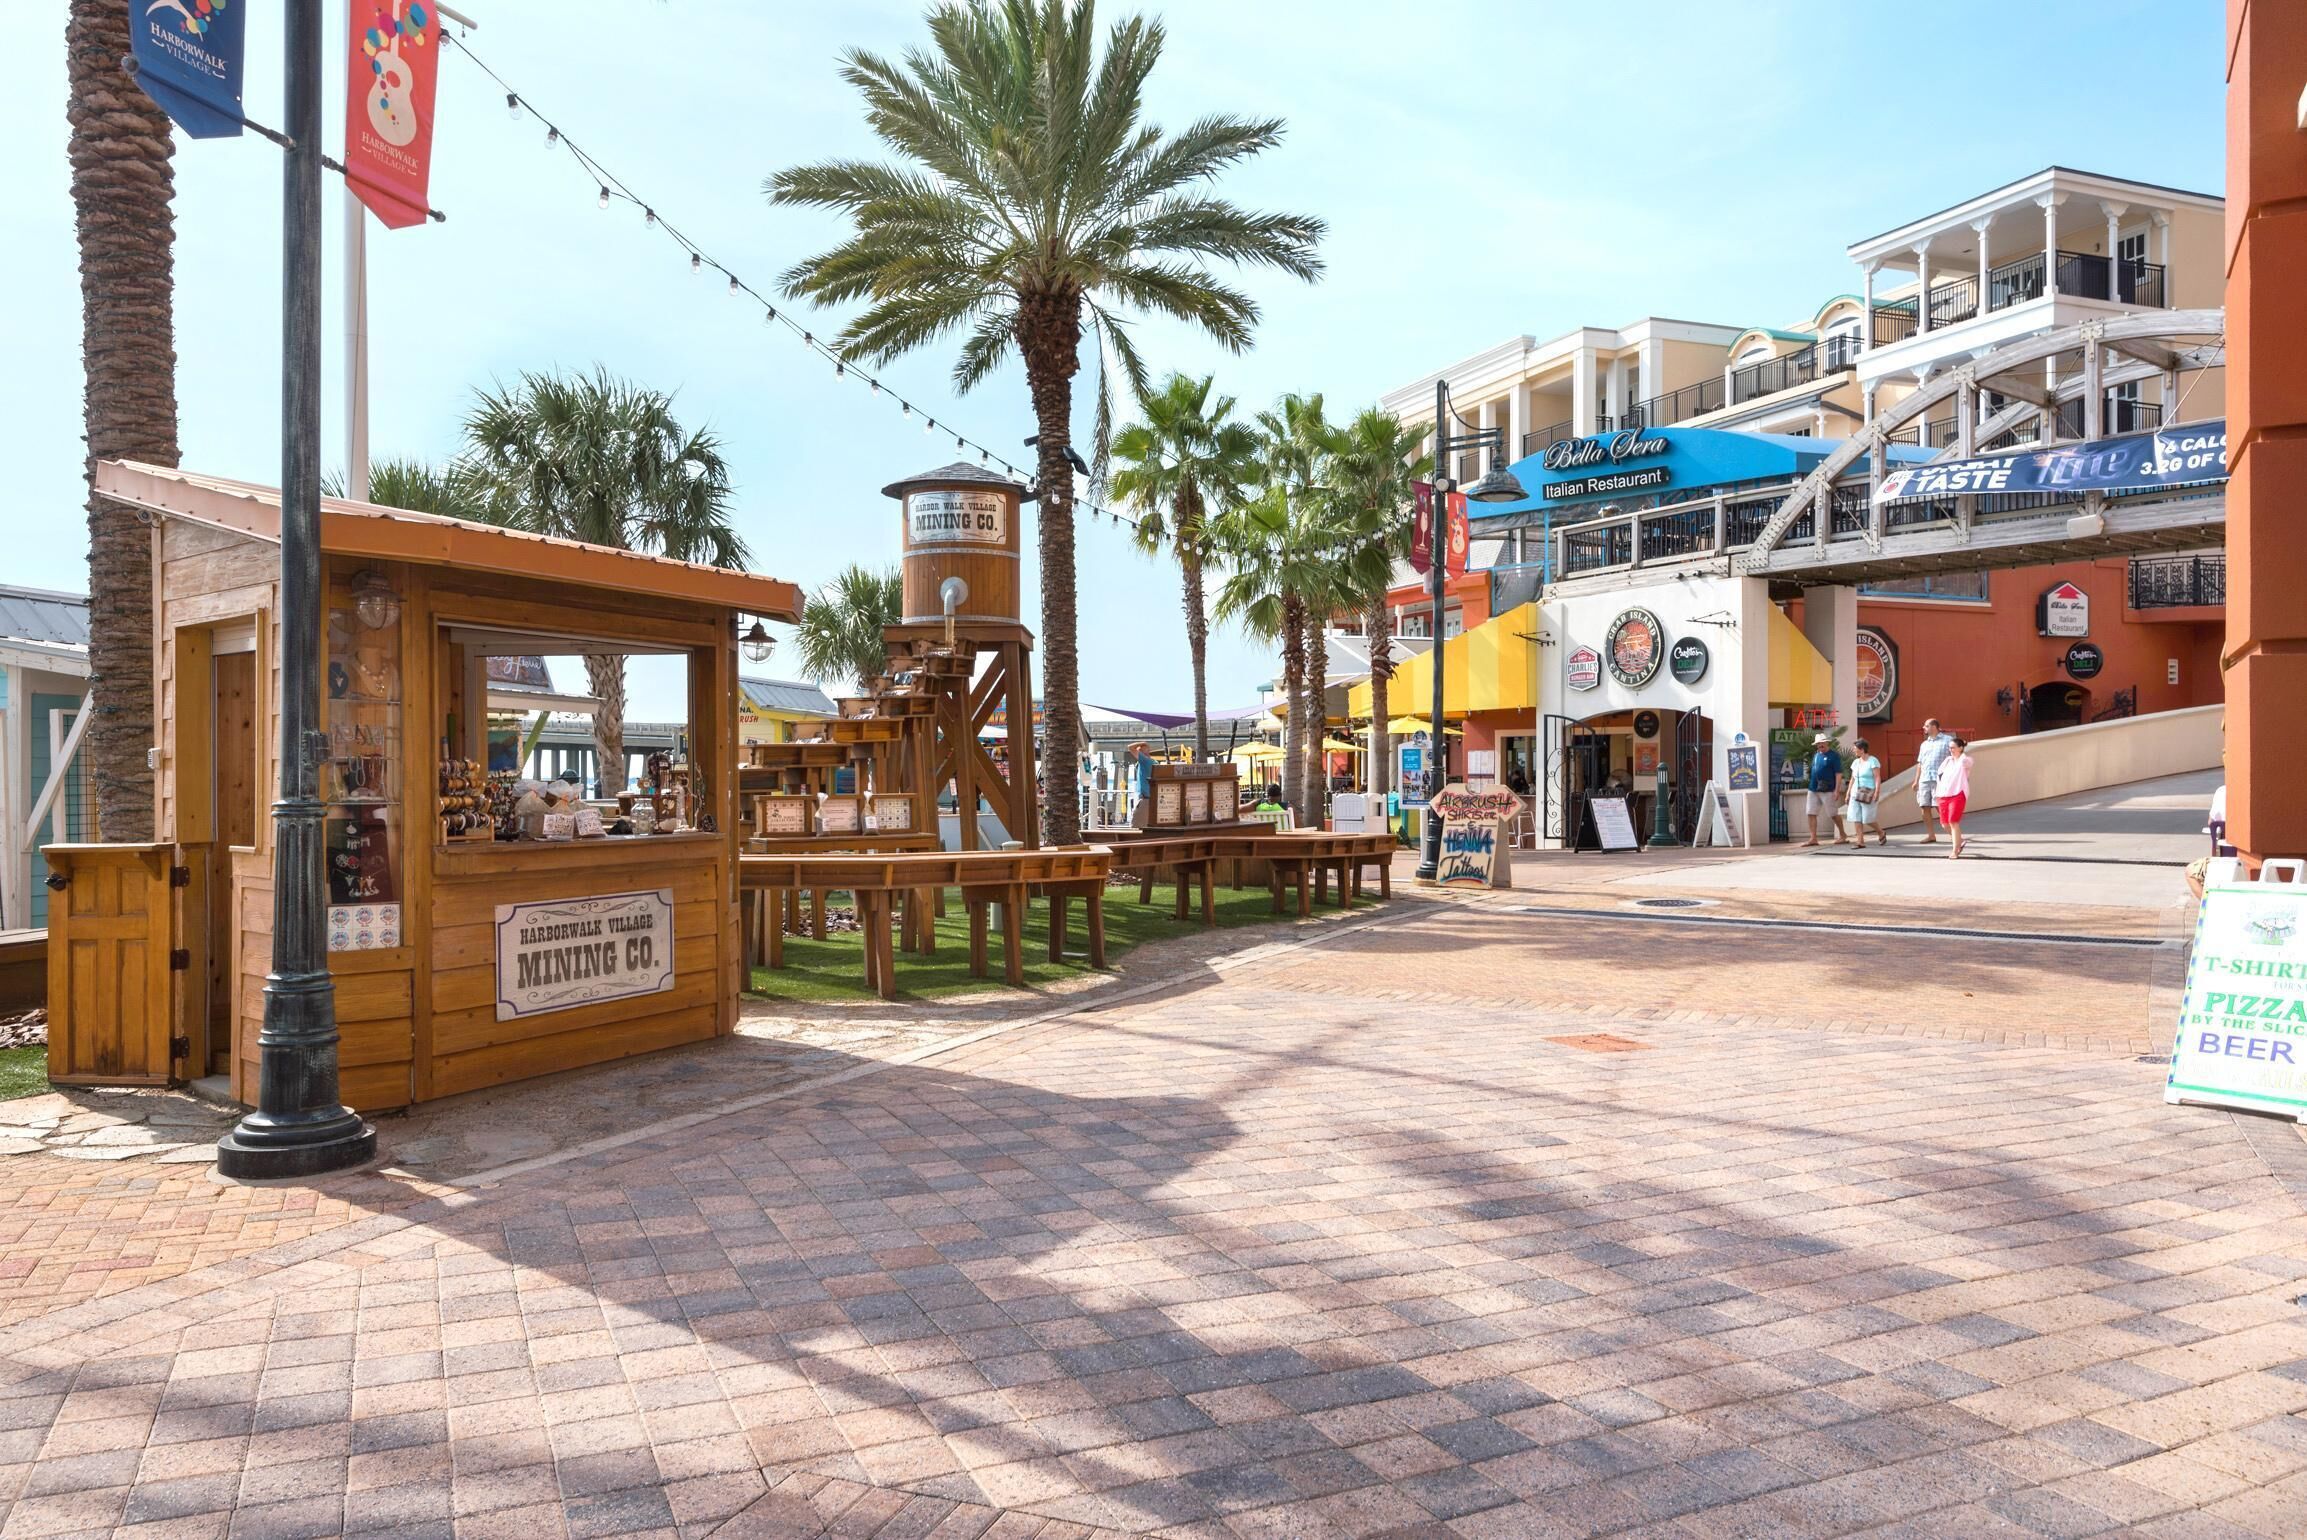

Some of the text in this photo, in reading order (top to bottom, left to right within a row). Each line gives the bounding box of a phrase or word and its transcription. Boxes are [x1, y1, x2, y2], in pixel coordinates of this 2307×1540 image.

[150, 21, 227, 72] HARBORWALK
[166, 44, 211, 76] VILLAGE
[361, 131, 418, 169] HARBORWALK
[372, 149, 406, 174] VILLAGE
[1543, 426, 1667, 471] Bella Sera
[2187, 453, 2215, 469] OF
[1546, 469, 1661, 498] Italian Restaurant
[1916, 469, 2012, 493] TASTE
[943, 502, 964, 511] WALK
[968, 503, 997, 512] VILLAGE
[915, 513, 998, 531] MINING CO.
[1608, 611, 1656, 640] CRAB ISLAND
[2051, 624, 2084, 632] Restaurant
[2059, 615, 2077, 623] Italian
[1858, 635, 1889, 663] ISLAND
[1567, 662, 1599, 675] CHARLIE'S
[1609, 662, 1655, 684] CANTINA
[2073, 659, 2093, 668] DELI
[1793, 708, 1841, 729] ATM
[1436, 792, 1516, 815] AIRBRUSH
[1444, 829, 1494, 854] HENNA
[1440, 853, 1492, 879] Tattoos!
[520, 914, 653, 945] HARBORWALK VILLAGE
[517, 935, 660, 989] MINING CO.
[2204, 991, 2307, 1023] PIZZA
[2191, 1014, 2213, 1025] BY
[2220, 1017, 2256, 1030] THE
[2198, 1031, 2296, 1065] BEER
